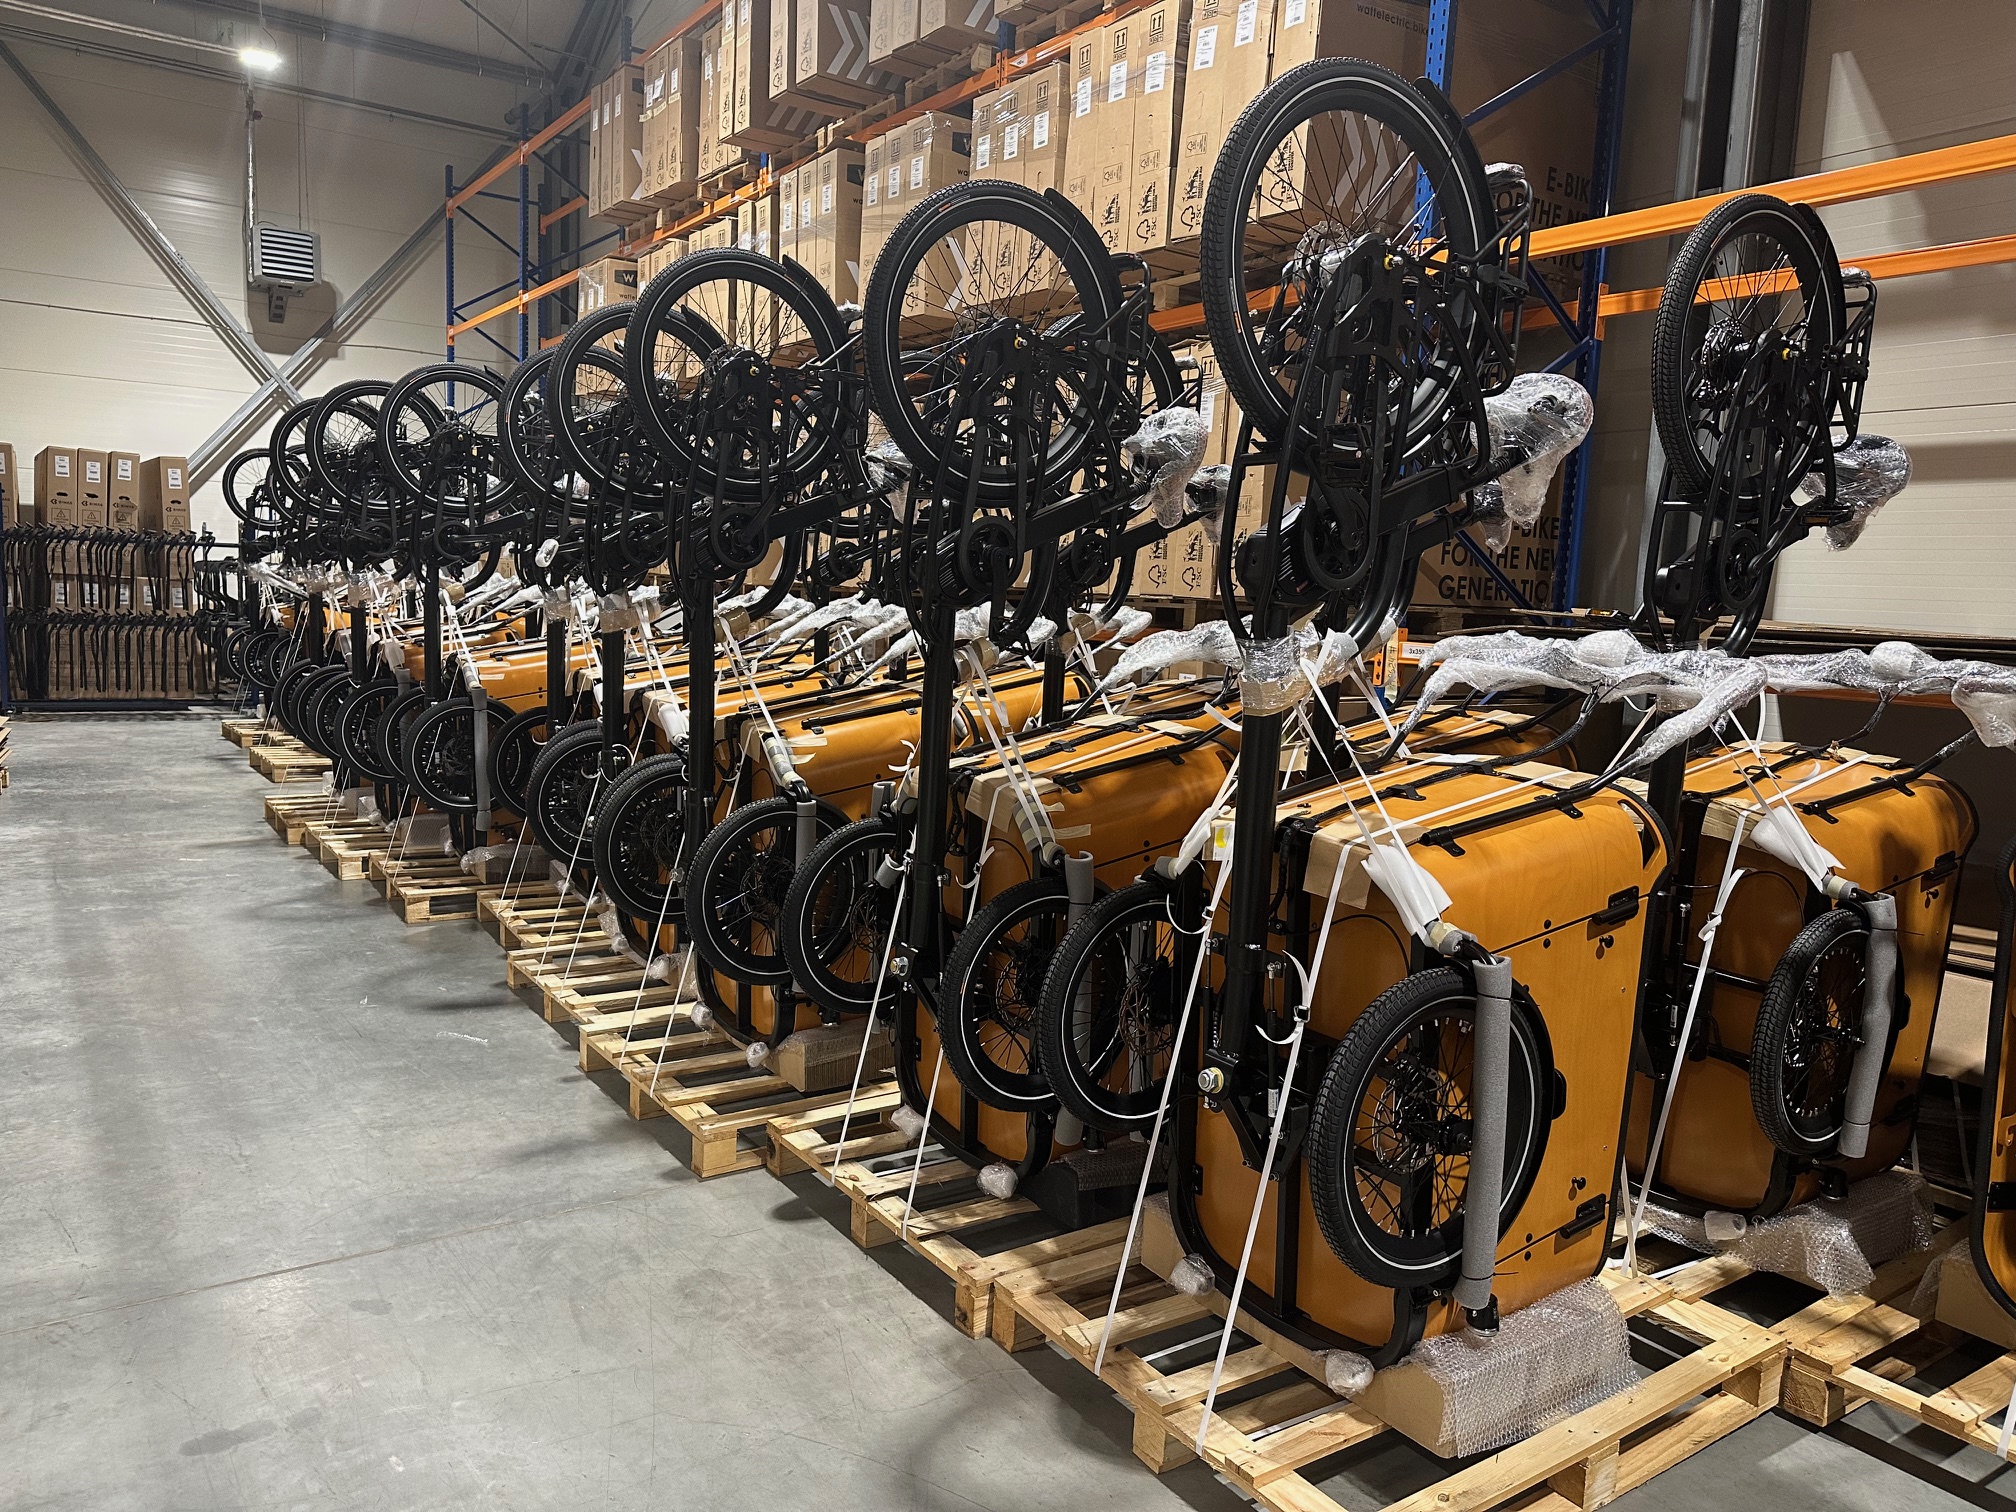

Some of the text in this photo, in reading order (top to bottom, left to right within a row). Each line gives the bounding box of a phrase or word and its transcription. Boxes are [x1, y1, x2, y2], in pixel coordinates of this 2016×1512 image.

[1546, 166, 1592, 204] E-BIK
[1514, 516, 1559, 540] -BIKE
[1439, 574, 1553, 603] GENERTIO
